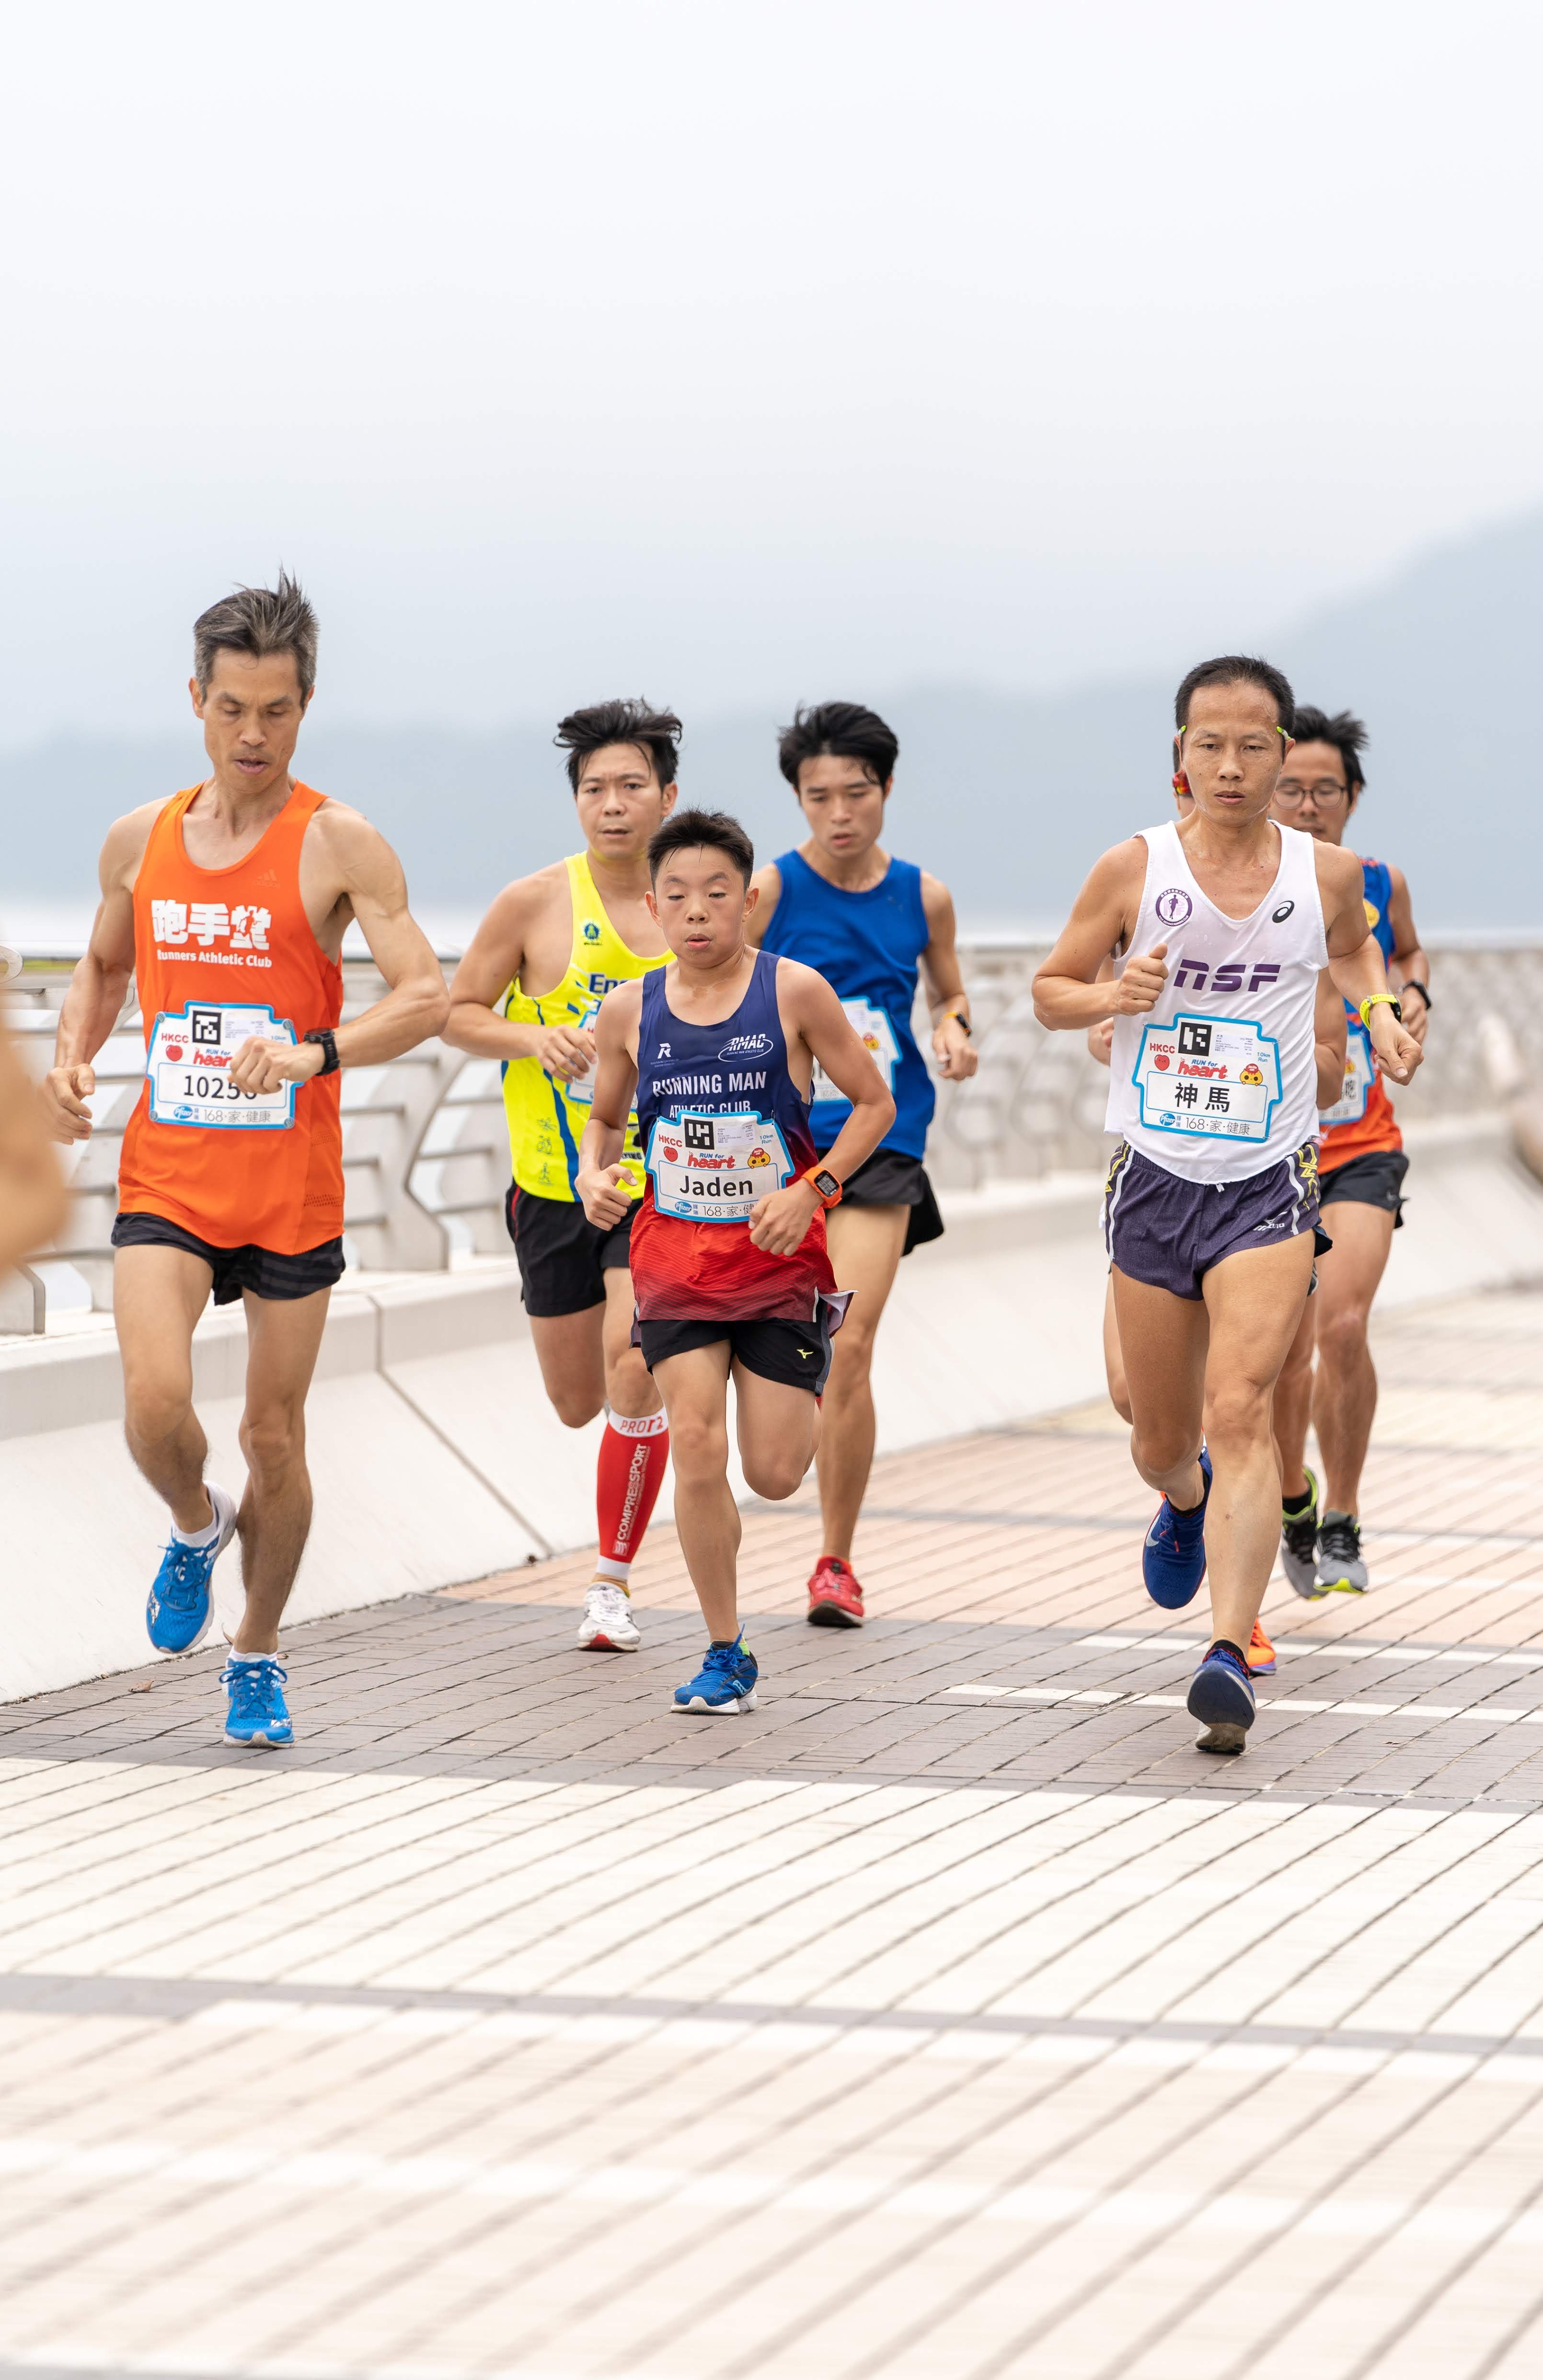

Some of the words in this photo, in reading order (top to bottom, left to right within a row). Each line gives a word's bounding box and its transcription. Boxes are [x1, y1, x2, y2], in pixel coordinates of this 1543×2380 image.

[198, 951, 243, 965] Athletic
[246, 954, 272, 968] Club
[589, 973, 629, 994] En
[161, 1032, 189, 1043] HKCC
[728, 1033, 766, 1052] RMAC
[1150, 1042, 1175, 1053] HKCC
[193, 1048, 233, 1067] hear
[1178, 1058, 1228, 1079] heart
[653, 1074, 722, 1097] RUNNING
[729, 1071, 767, 1092] MAN
[1175, 1082, 1231, 1113] 神馬
[658, 1134, 683, 1147] HKCC
[687, 1151, 736, 1169] heart
[679, 1176, 753, 1197] Jaden
[617, 1443, 647, 1541] COMPRESSPORT
